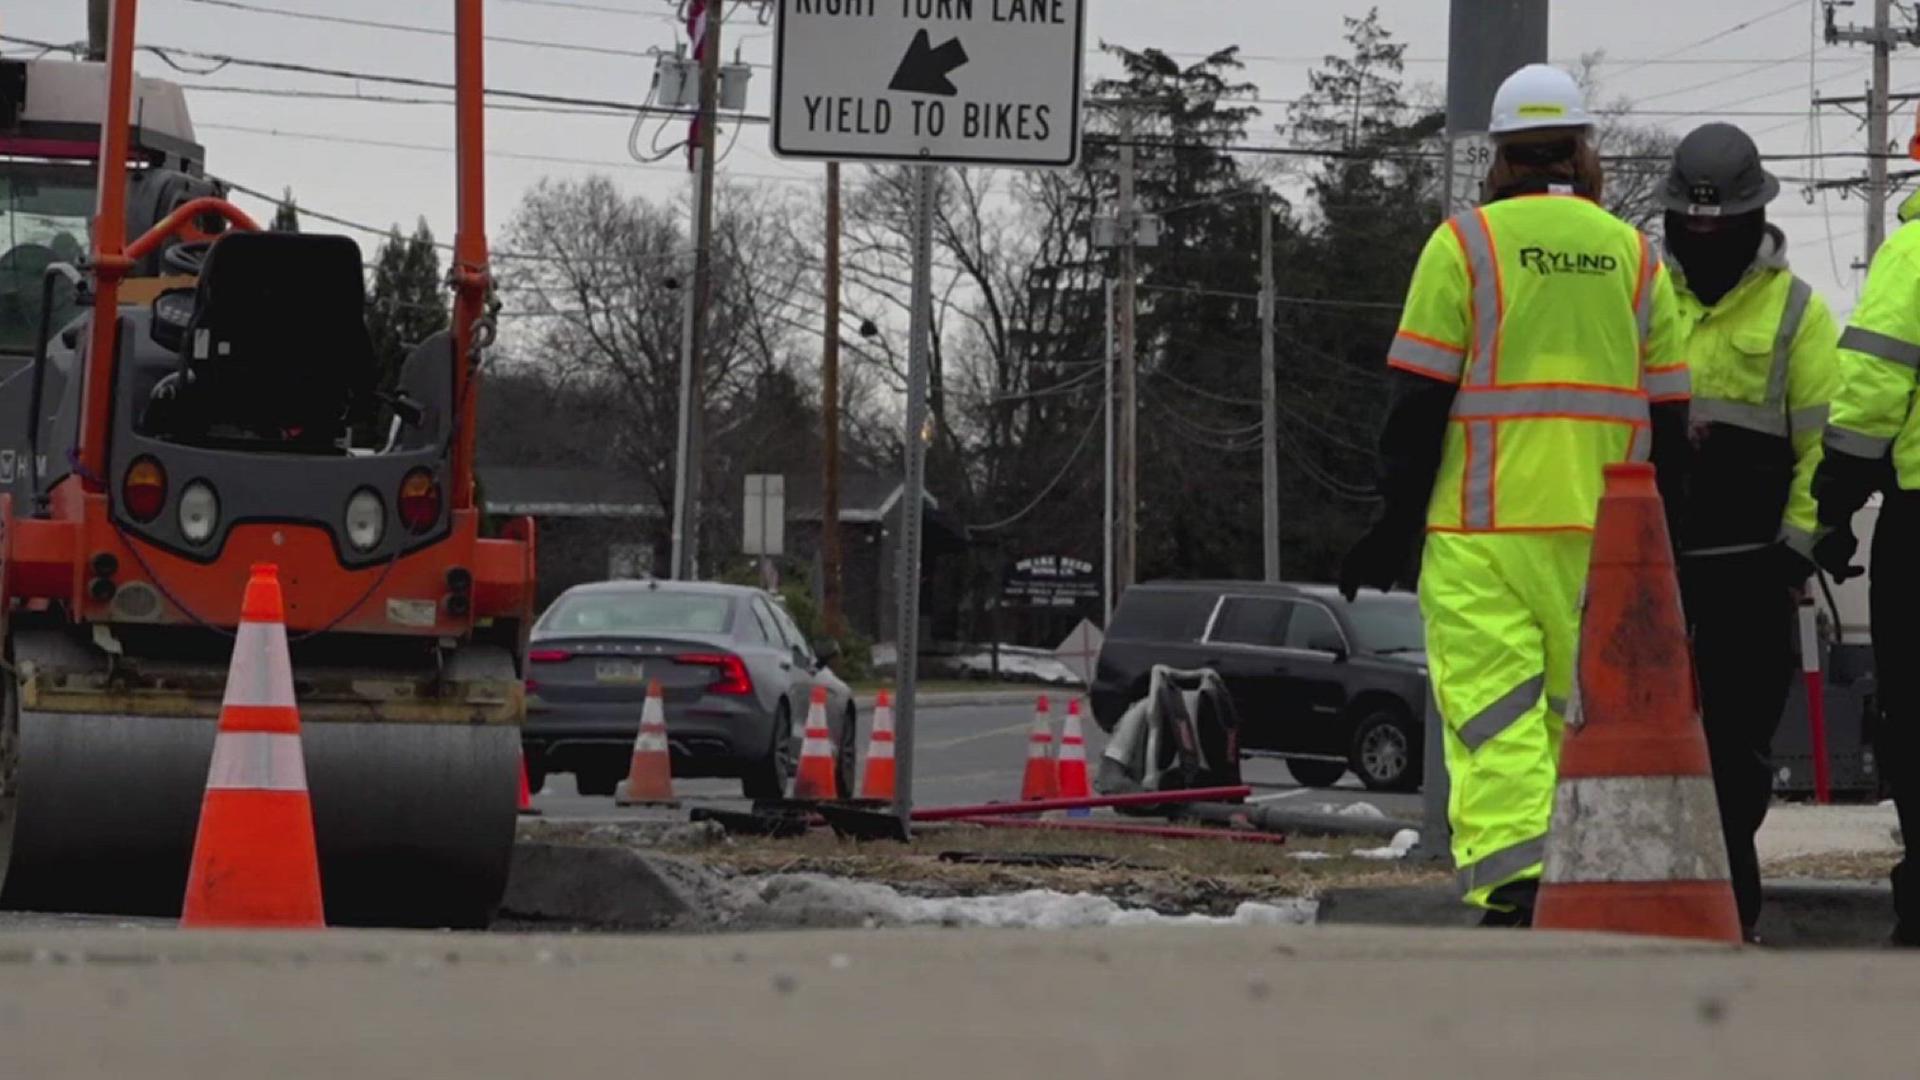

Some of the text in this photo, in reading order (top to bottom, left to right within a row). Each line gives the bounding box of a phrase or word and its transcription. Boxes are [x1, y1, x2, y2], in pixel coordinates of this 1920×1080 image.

[992, 0, 1065, 24] LANE
[803, 95, 1050, 140] YIELD TO BIKES
[1520, 246, 1617, 275] RYLIND
